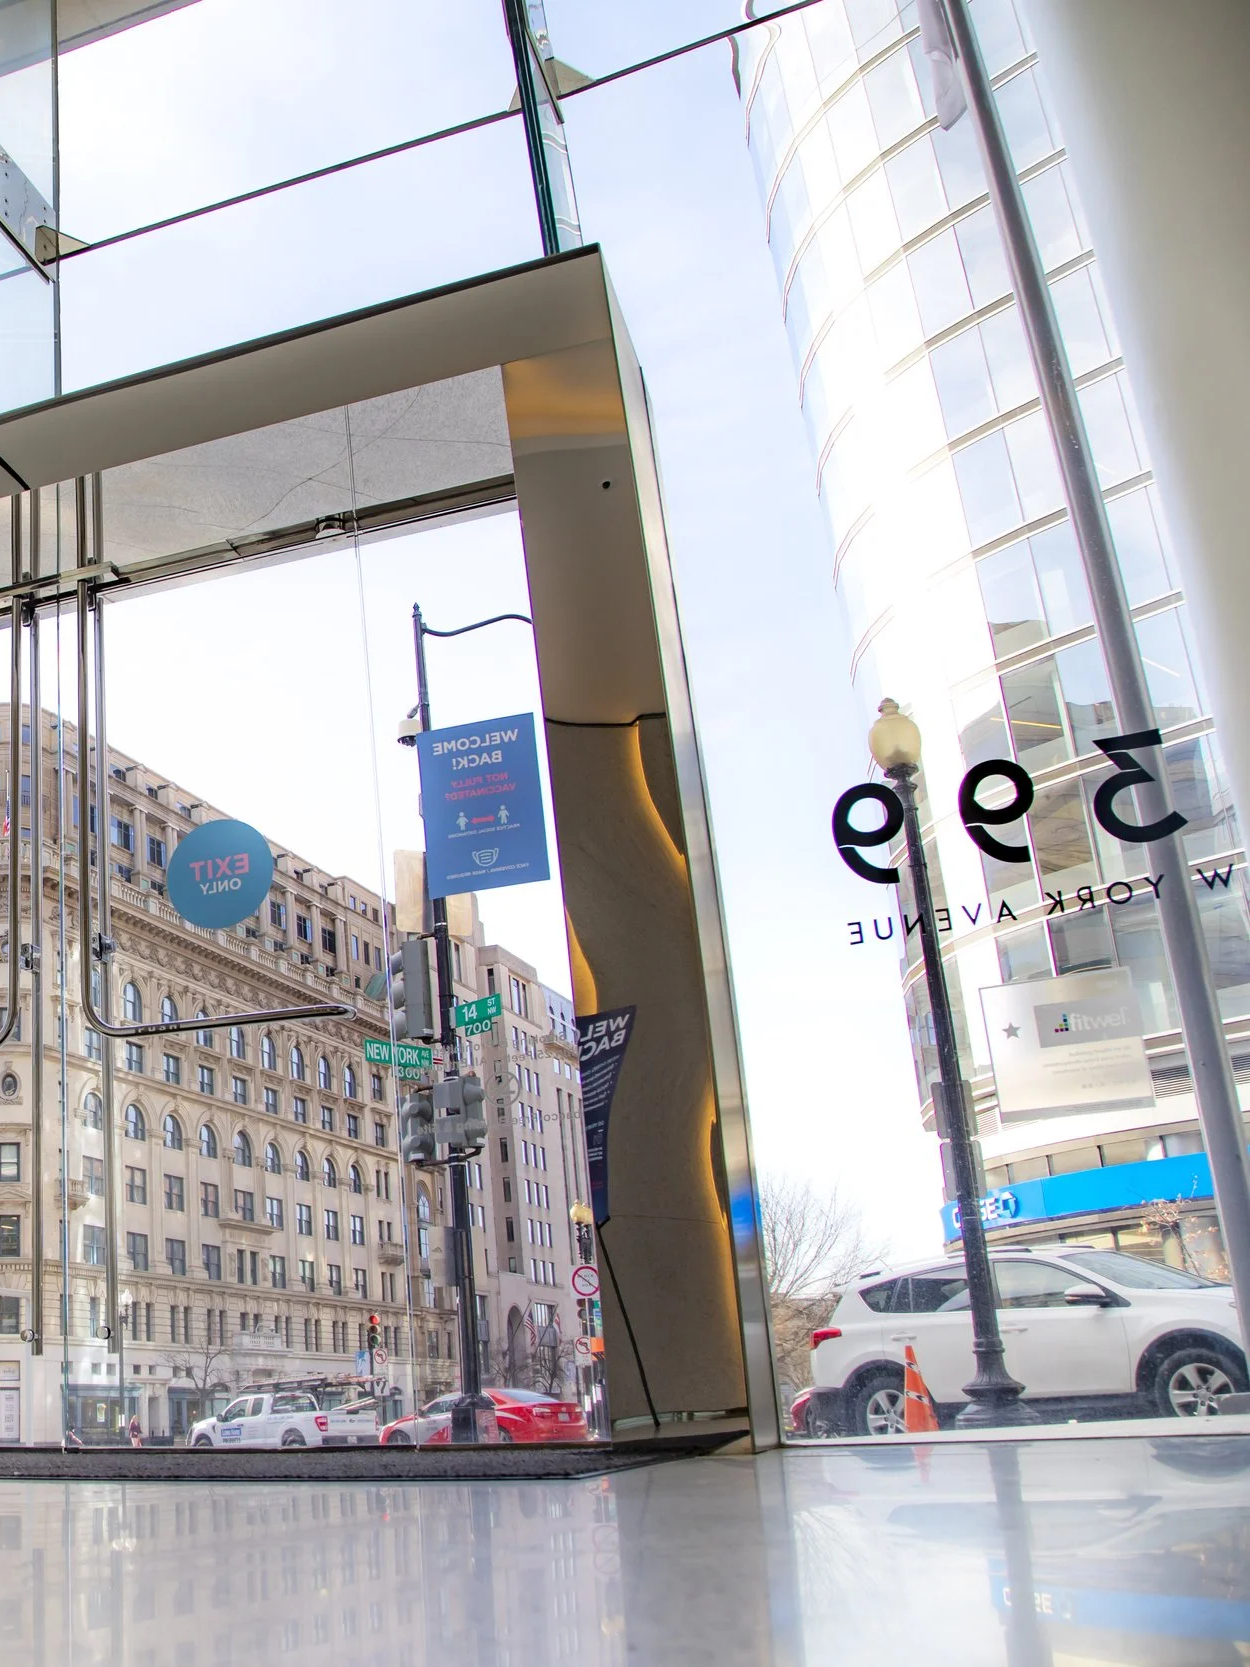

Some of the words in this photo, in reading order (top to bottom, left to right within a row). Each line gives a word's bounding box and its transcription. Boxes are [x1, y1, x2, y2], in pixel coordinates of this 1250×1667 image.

[461, 1003, 478, 1022] 14
[487, 997, 496, 1007] ST
[487, 1006, 497, 1015] NW
[465, 1019, 492, 1036] 700
[1068, 1006, 1128, 1032] fitwel
[138, 1023, 178, 1034] PUSH
[366, 1042, 390, 1061] NEW
[421, 1049, 430, 1058] AVE
[395, 1066, 420, 1080] 300
[952, 1197, 999, 1229] CSE
